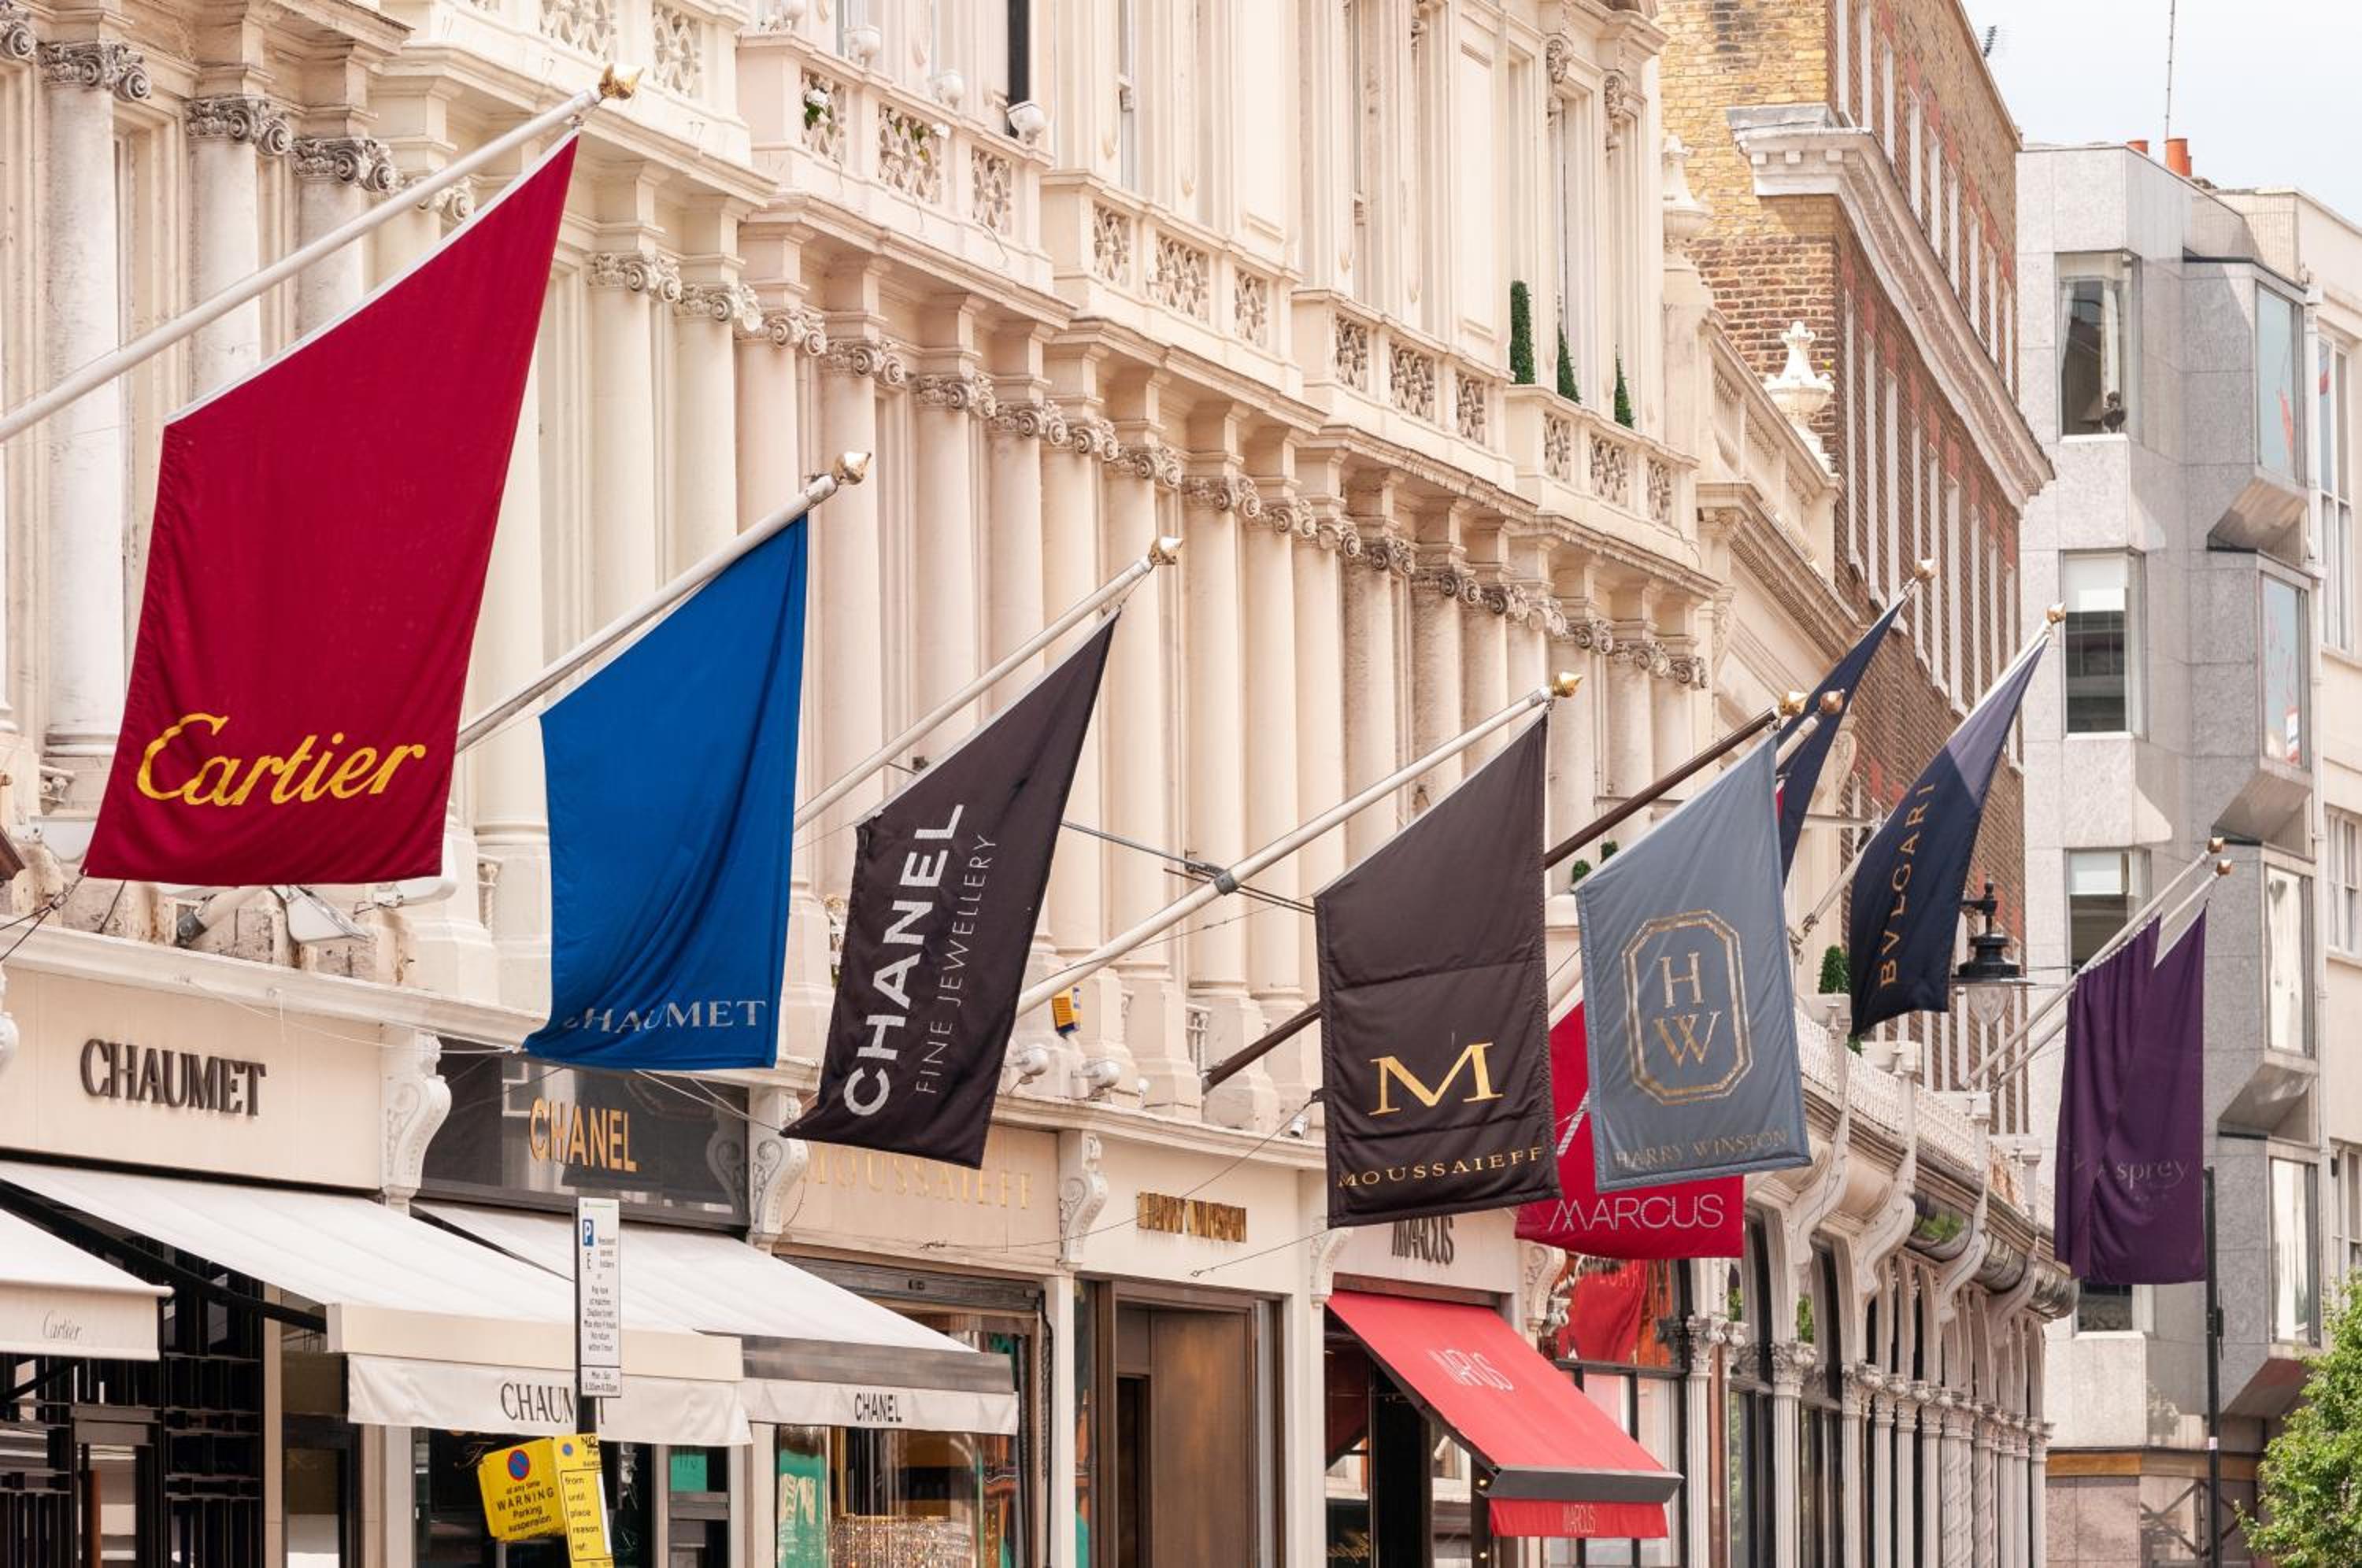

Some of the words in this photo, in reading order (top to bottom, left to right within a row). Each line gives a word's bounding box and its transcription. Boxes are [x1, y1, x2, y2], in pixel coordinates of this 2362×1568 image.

[137, 713, 426, 806] Cartier
[1879, 784, 1934, 988] BVLGARI
[844, 804, 964, 1115] CHANEL
[916, 1020, 952, 1094] FINE
[938, 834, 997, 1007] JEWELLERY
[1660, 952, 1704, 1008] H
[1653, 1010, 1722, 1069] W
[80, 1038, 267, 1116] CHAUMET
[1368, 1042, 1503, 1115] M
[529, 1096, 642, 1172] CHANEL
[1615, 1145, 1683, 1168] HARRY
[1338, 1146, 1542, 1187] MOUSSAIEFF
[1549, 1194, 1724, 1232] MARCUS
[855, 1392, 902, 1422] CHANEL
[497, 1487, 554, 1511] WARNING
[508, 1515, 552, 1533] suspension
[513, 1505, 542, 1518] Parking
